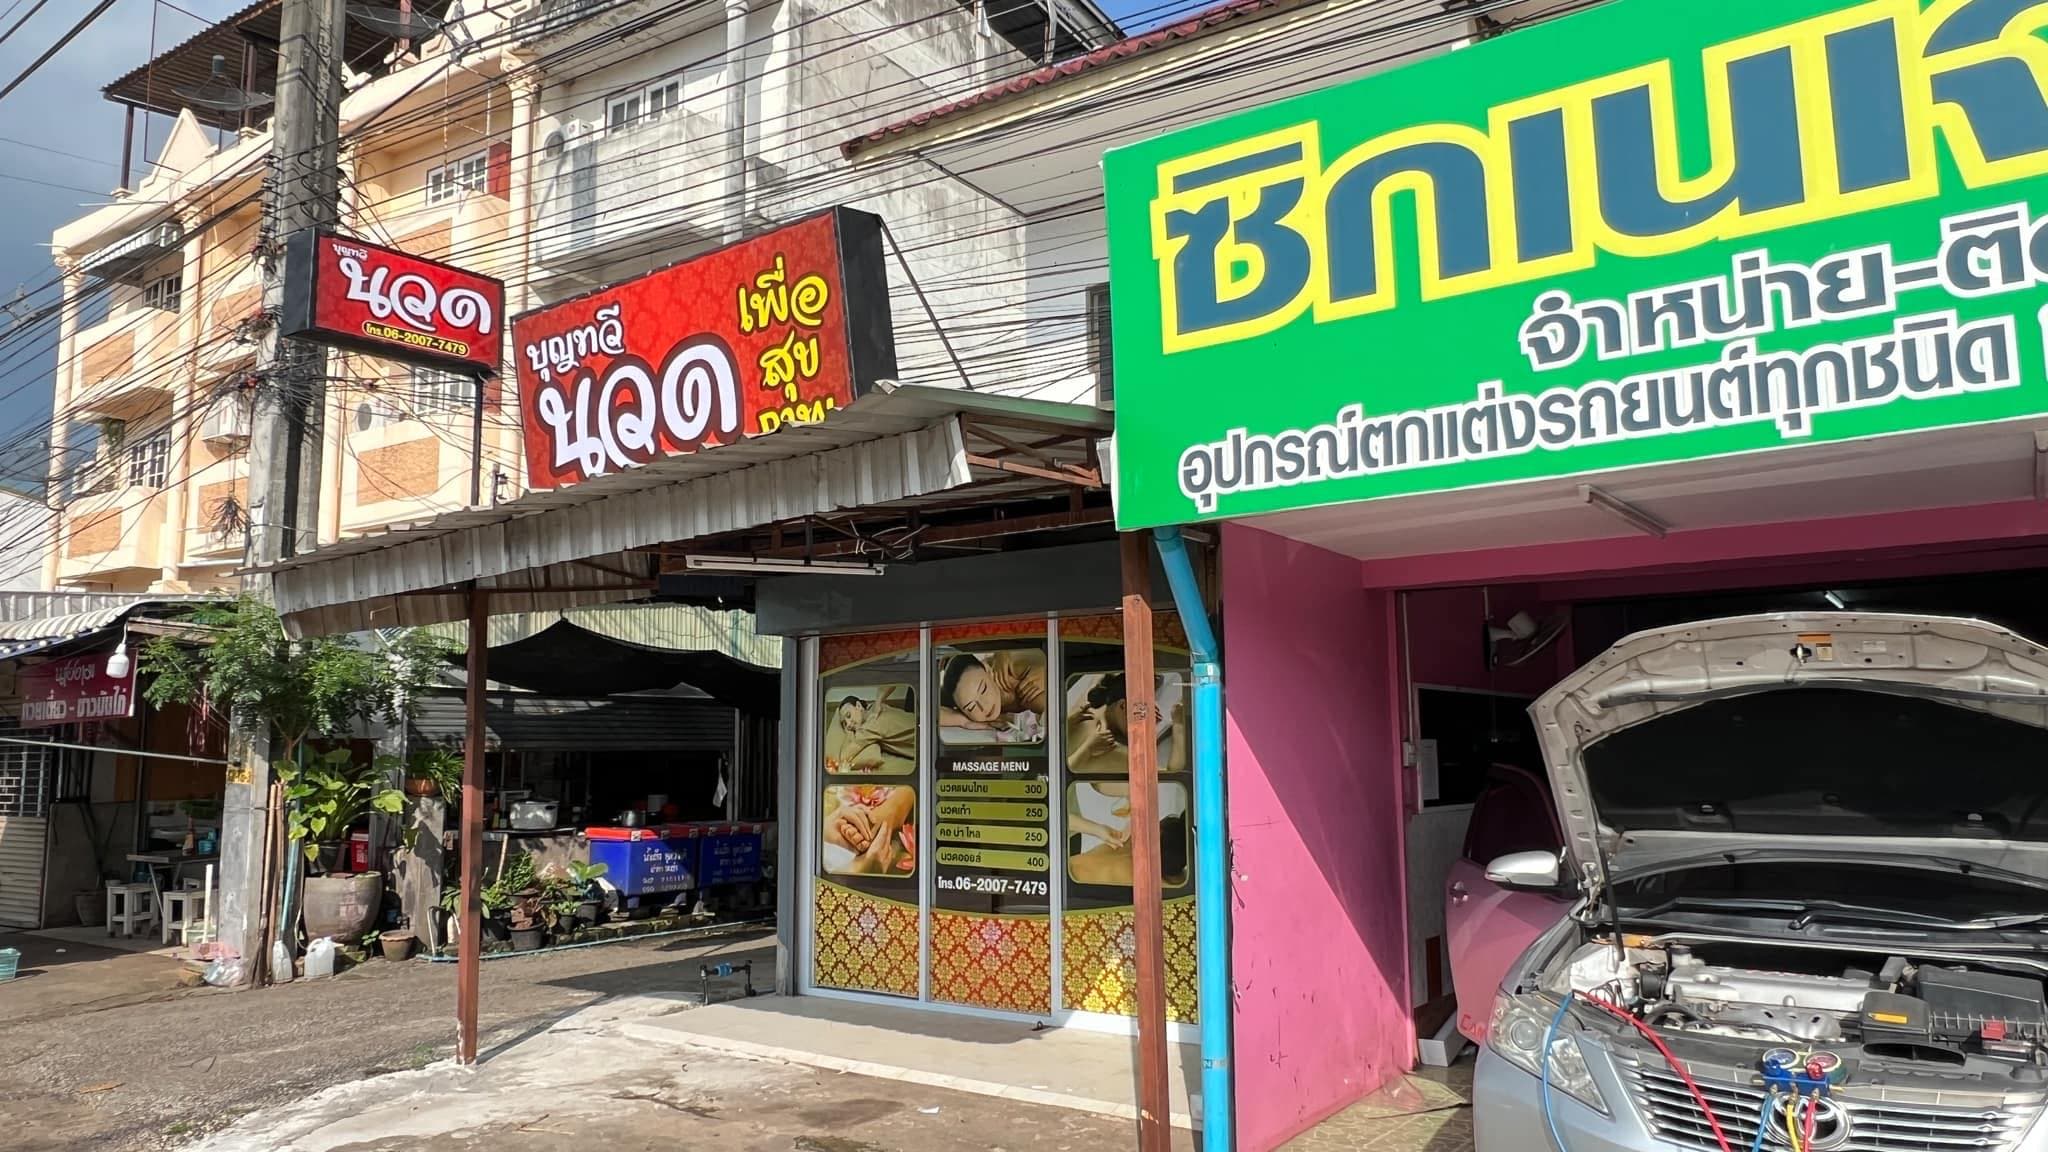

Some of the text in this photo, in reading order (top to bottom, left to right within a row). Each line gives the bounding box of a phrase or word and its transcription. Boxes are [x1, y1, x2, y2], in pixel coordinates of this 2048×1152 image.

[339, 257, 491, 334] นวด
[738, 256, 828, 332] เพื่อ
[526, 305, 625, 382] บุญทวี
[760, 332, 820, 401] สุข
[539, 344, 738, 478] นวด
[1180, 313, 2014, 509] อุปกรณ์ตกแต่งรถยนต์ทุกชนิด
[940, 781, 1042, 794] นวดแผนไทย 300
[952, 761, 1030, 771] MASSAGE MENU
[1026, 808, 1042, 817] 250
[1025, 832, 1042, 841] 250
[1027, 857, 1044, 867] 400
[938, 876, 1048, 895] โทร.06-2007-7479
